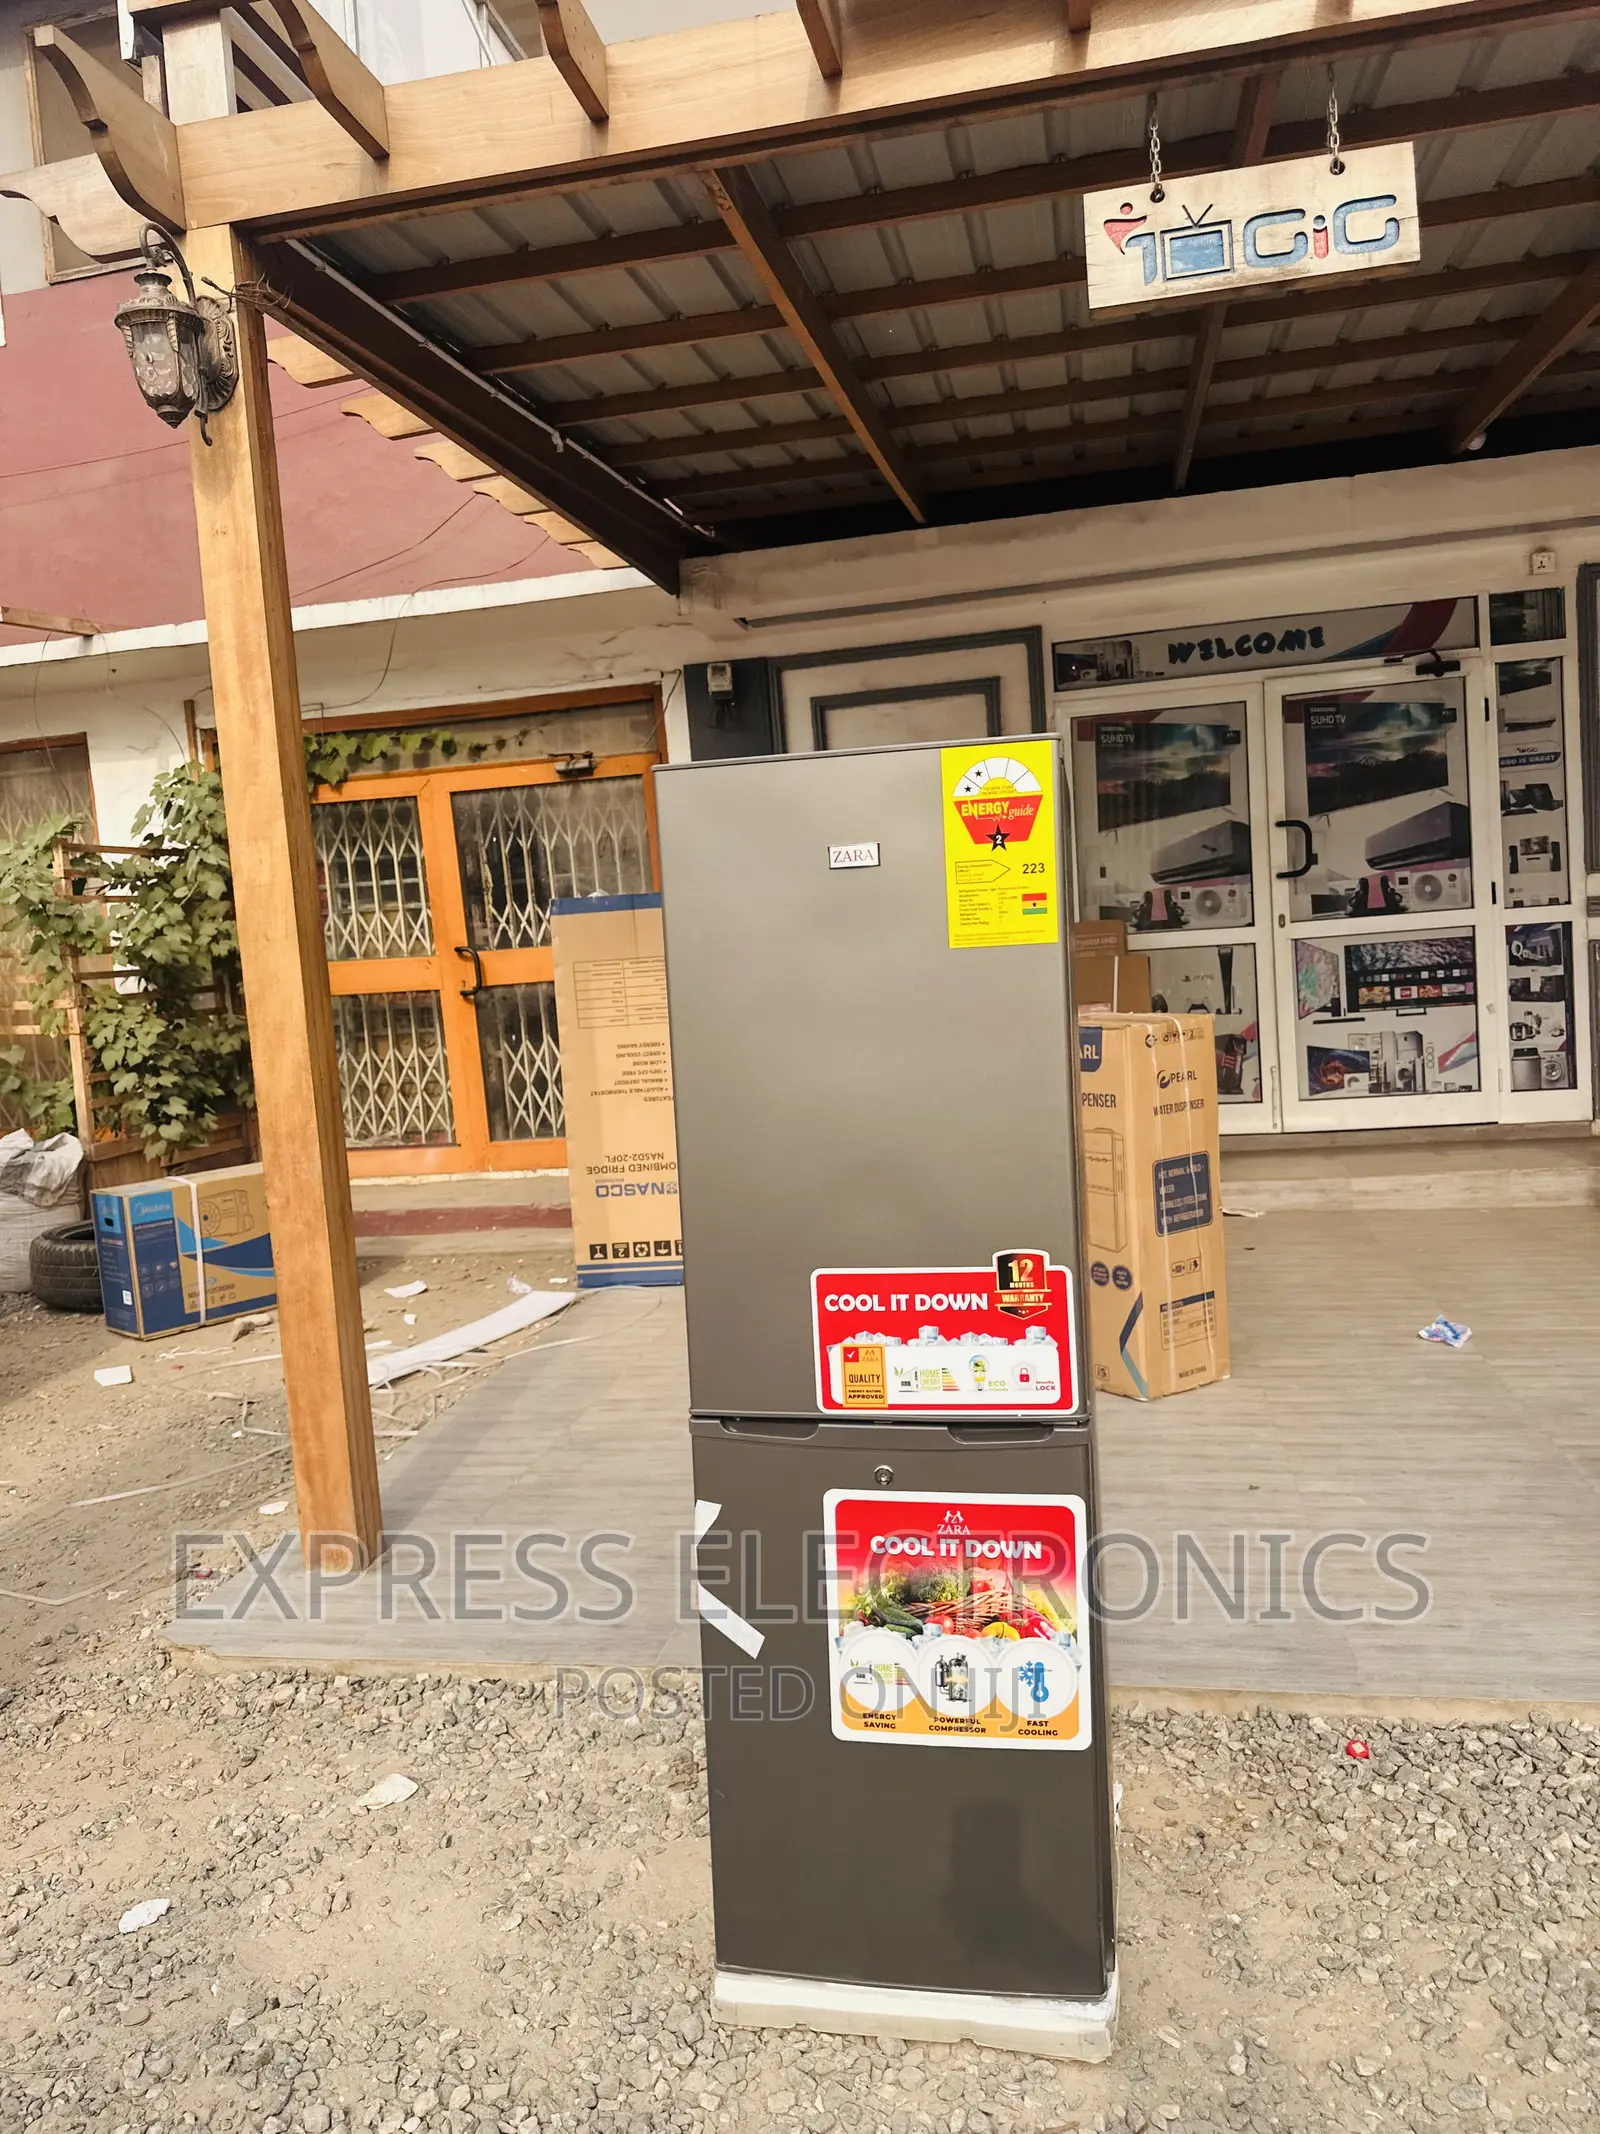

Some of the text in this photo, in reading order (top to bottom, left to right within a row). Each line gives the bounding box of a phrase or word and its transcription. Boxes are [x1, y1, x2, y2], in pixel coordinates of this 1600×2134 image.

[1168, 626, 1326, 664] WELCOME
[1335, 714, 1347, 724] TV
[961, 801, 1034, 820] ENERGY guide
[995, 834, 1002, 844] 2
[832, 848, 875, 864] ZARA
[1022, 862, 1045, 875] 223
[590, 1088, 627, 1096] THERMOSTAT
[1082, 1092, 1117, 1108] PENSER
[1174, 1099, 1205, 1113] DISPNSER
[604, 1152, 664, 1163] NASD2-20FL
[586, 1161, 677, 1175] OMBINED FRIDGE
[595, 1182, 665, 1198] NASCO
[1008, 1259, 1034, 1282] 12
[824, 1293, 989, 1312] COOL IT DOWN
[1001, 1293, 1044, 1303] WARRANTY
[848, 1374, 881, 1383] QUALITY
[919, 1369, 940, 1378] HOME
[937, 1524, 971, 1535] ZARA
[870, 1536, 1042, 1559] COOL IT DOWN
[862, 1712, 897, 1720] ENERGY
[933, 1716, 981, 1725] POWERFUL
[863, 1721, 896, 1729] SAVING
[928, 1724, 987, 1734] COMPRESSOR
[1018, 1728, 1059, 1736] COOLING
